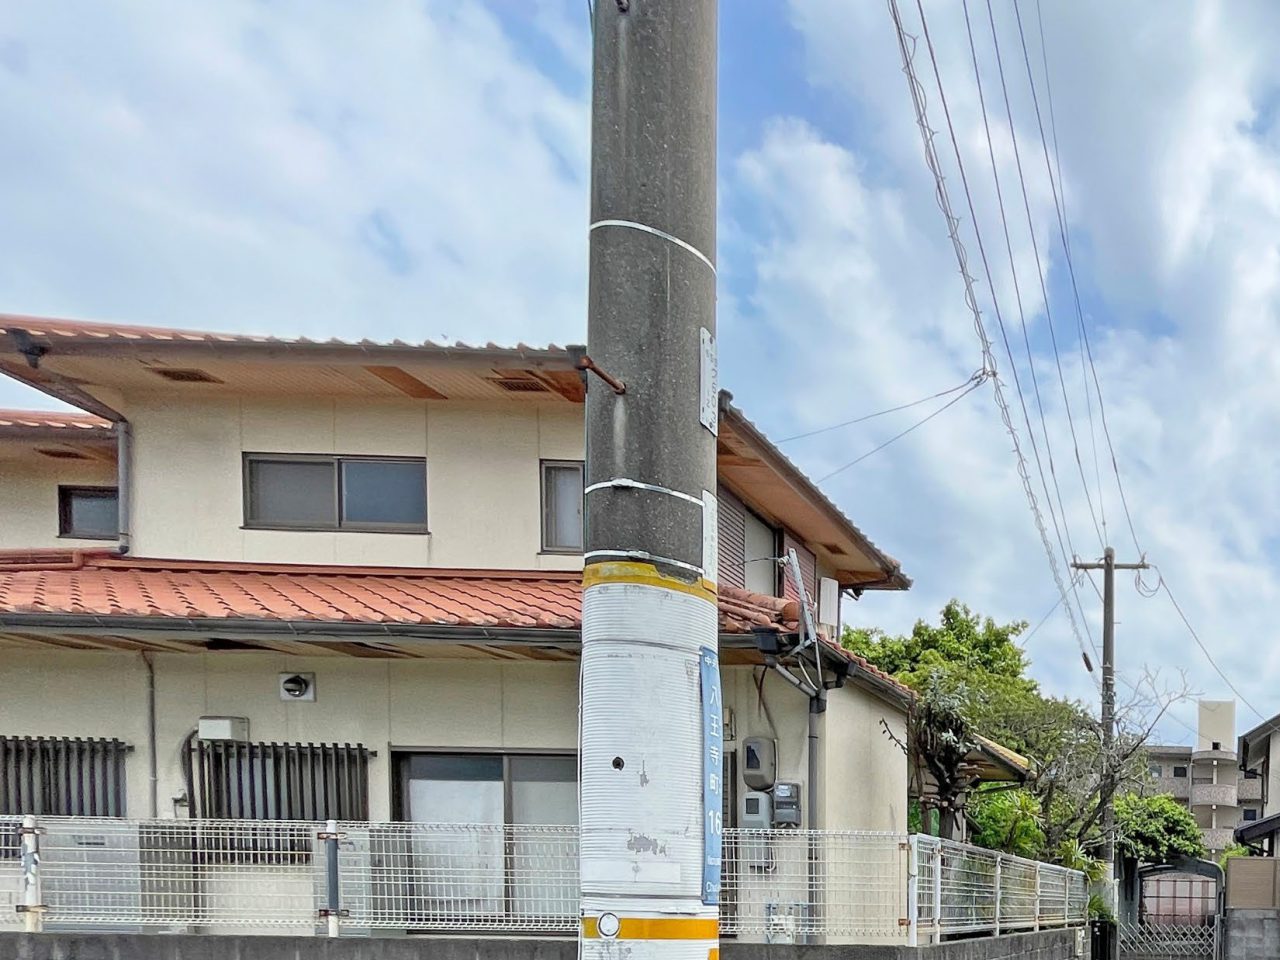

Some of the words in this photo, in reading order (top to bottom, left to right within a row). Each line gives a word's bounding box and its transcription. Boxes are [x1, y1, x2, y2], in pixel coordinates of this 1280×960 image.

[709, 685, 720, 795] 八王寺町
[708, 809, 721, 835] 16
